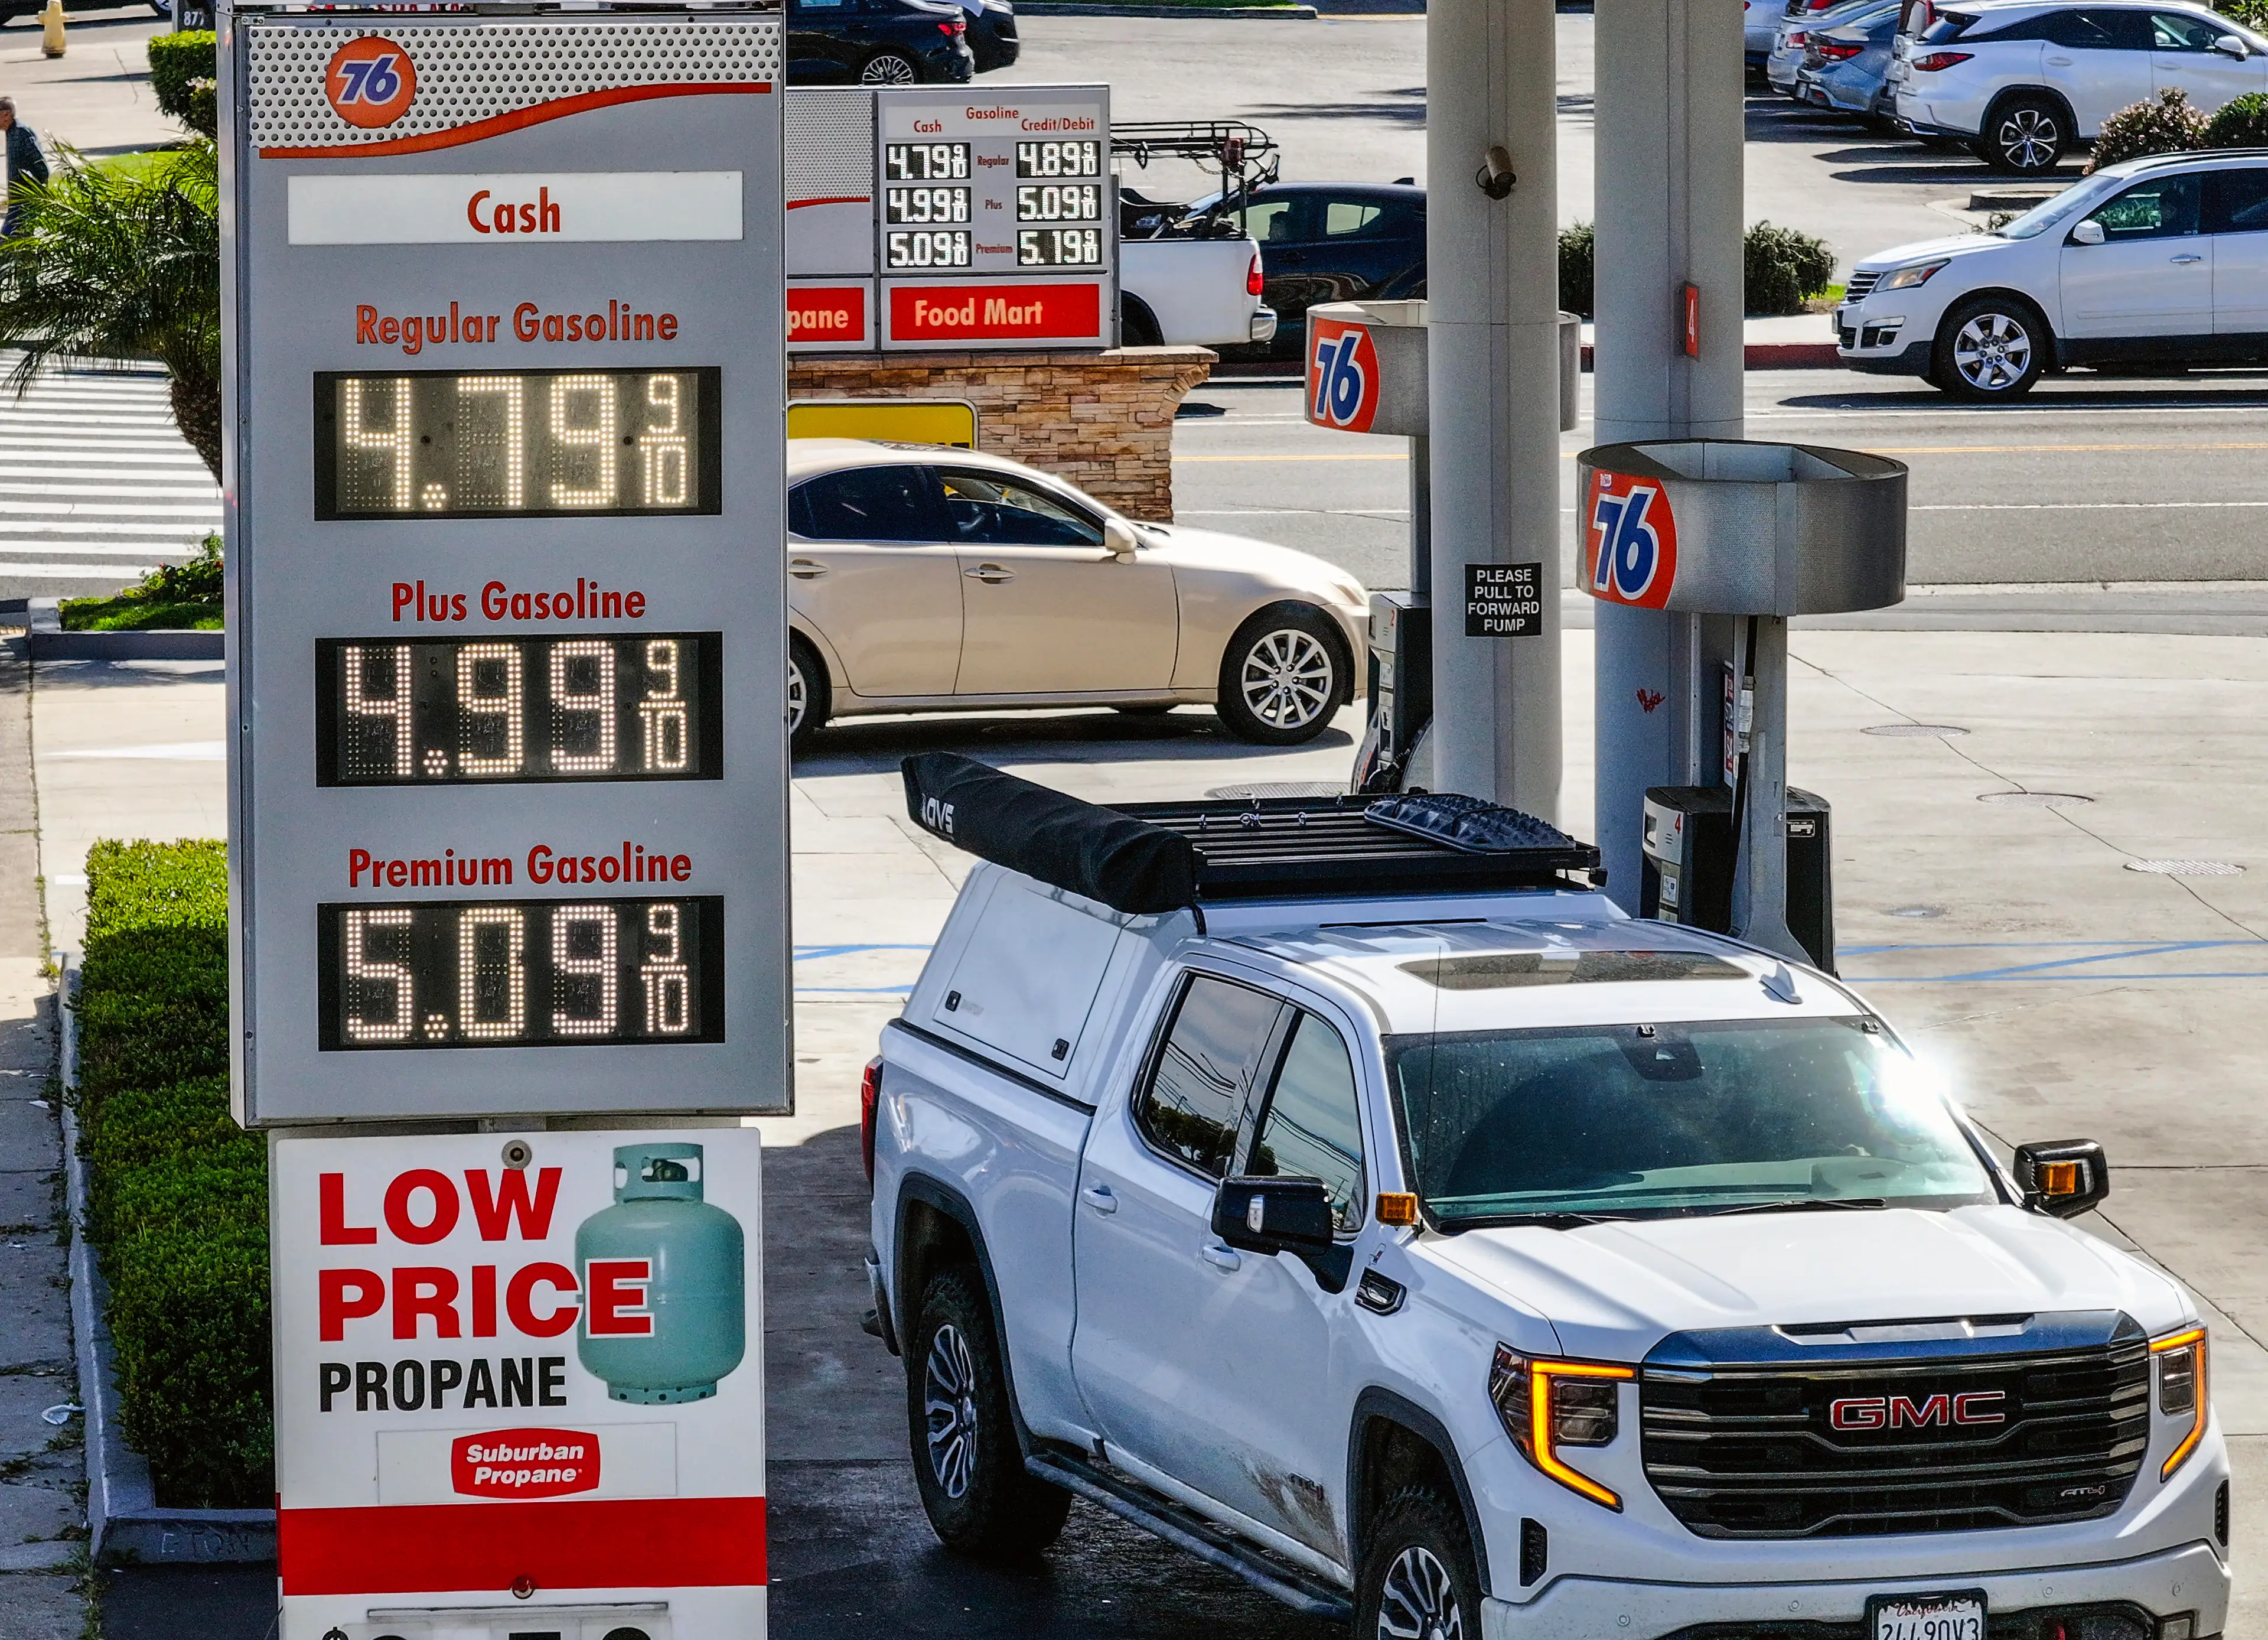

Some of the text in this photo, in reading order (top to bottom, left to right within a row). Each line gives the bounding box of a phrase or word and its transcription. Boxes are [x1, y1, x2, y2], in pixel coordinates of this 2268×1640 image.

[335, 54, 402, 106] 76
[914, 118, 1096, 133] Cash Credit/Debit
[966, 106, 1019, 119] Gasoline
[888, 144, 950, 179] 4.79
[977, 155, 1010, 167] Regular
[1018, 142, 1081, 177] 4.89
[467, 187, 561, 233] Cash
[889, 188, 951, 223] 4.99
[985, 199, 1003, 210] Plus
[1018, 186, 1080, 220] 5.09
[889, 232, 951, 266] 5.09
[975, 243, 1014, 255] Premium
[1019, 230, 1082, 265] 5.19
[356, 299, 678, 355] Regular Gasoline
[915, 297, 1043, 327] Food Mart
[1314, 330, 1366, 427] 76
[346, 374, 615, 509] 4.79
[1592, 484, 1660, 601] 76
[1474, 584, 1534, 599] PULL TO
[1477, 568, 1532, 583] PLEASE
[392, 577, 646, 622] Plus Gasoline
[1468, 601, 1540, 616] FORWARD
[1484, 618, 1526, 632] PUMP
[346, 640, 615, 775] 4.99
[927, 797, 955, 834] OVS
[348, 841, 692, 887] Premium Gasoline
[346, 905, 617, 1039] 5.09
[319, 1167, 563, 1245] LOW
[319, 1261, 651, 1342] PRICE
[319, 1356, 568, 1413] PROPANE
[1830, 1390, 2006, 1431] GMC
[467, 1443, 584, 1463] Suburban
[474, 1466, 576, 1488] Propane
[2060, 1485, 2106, 1497] AT4
